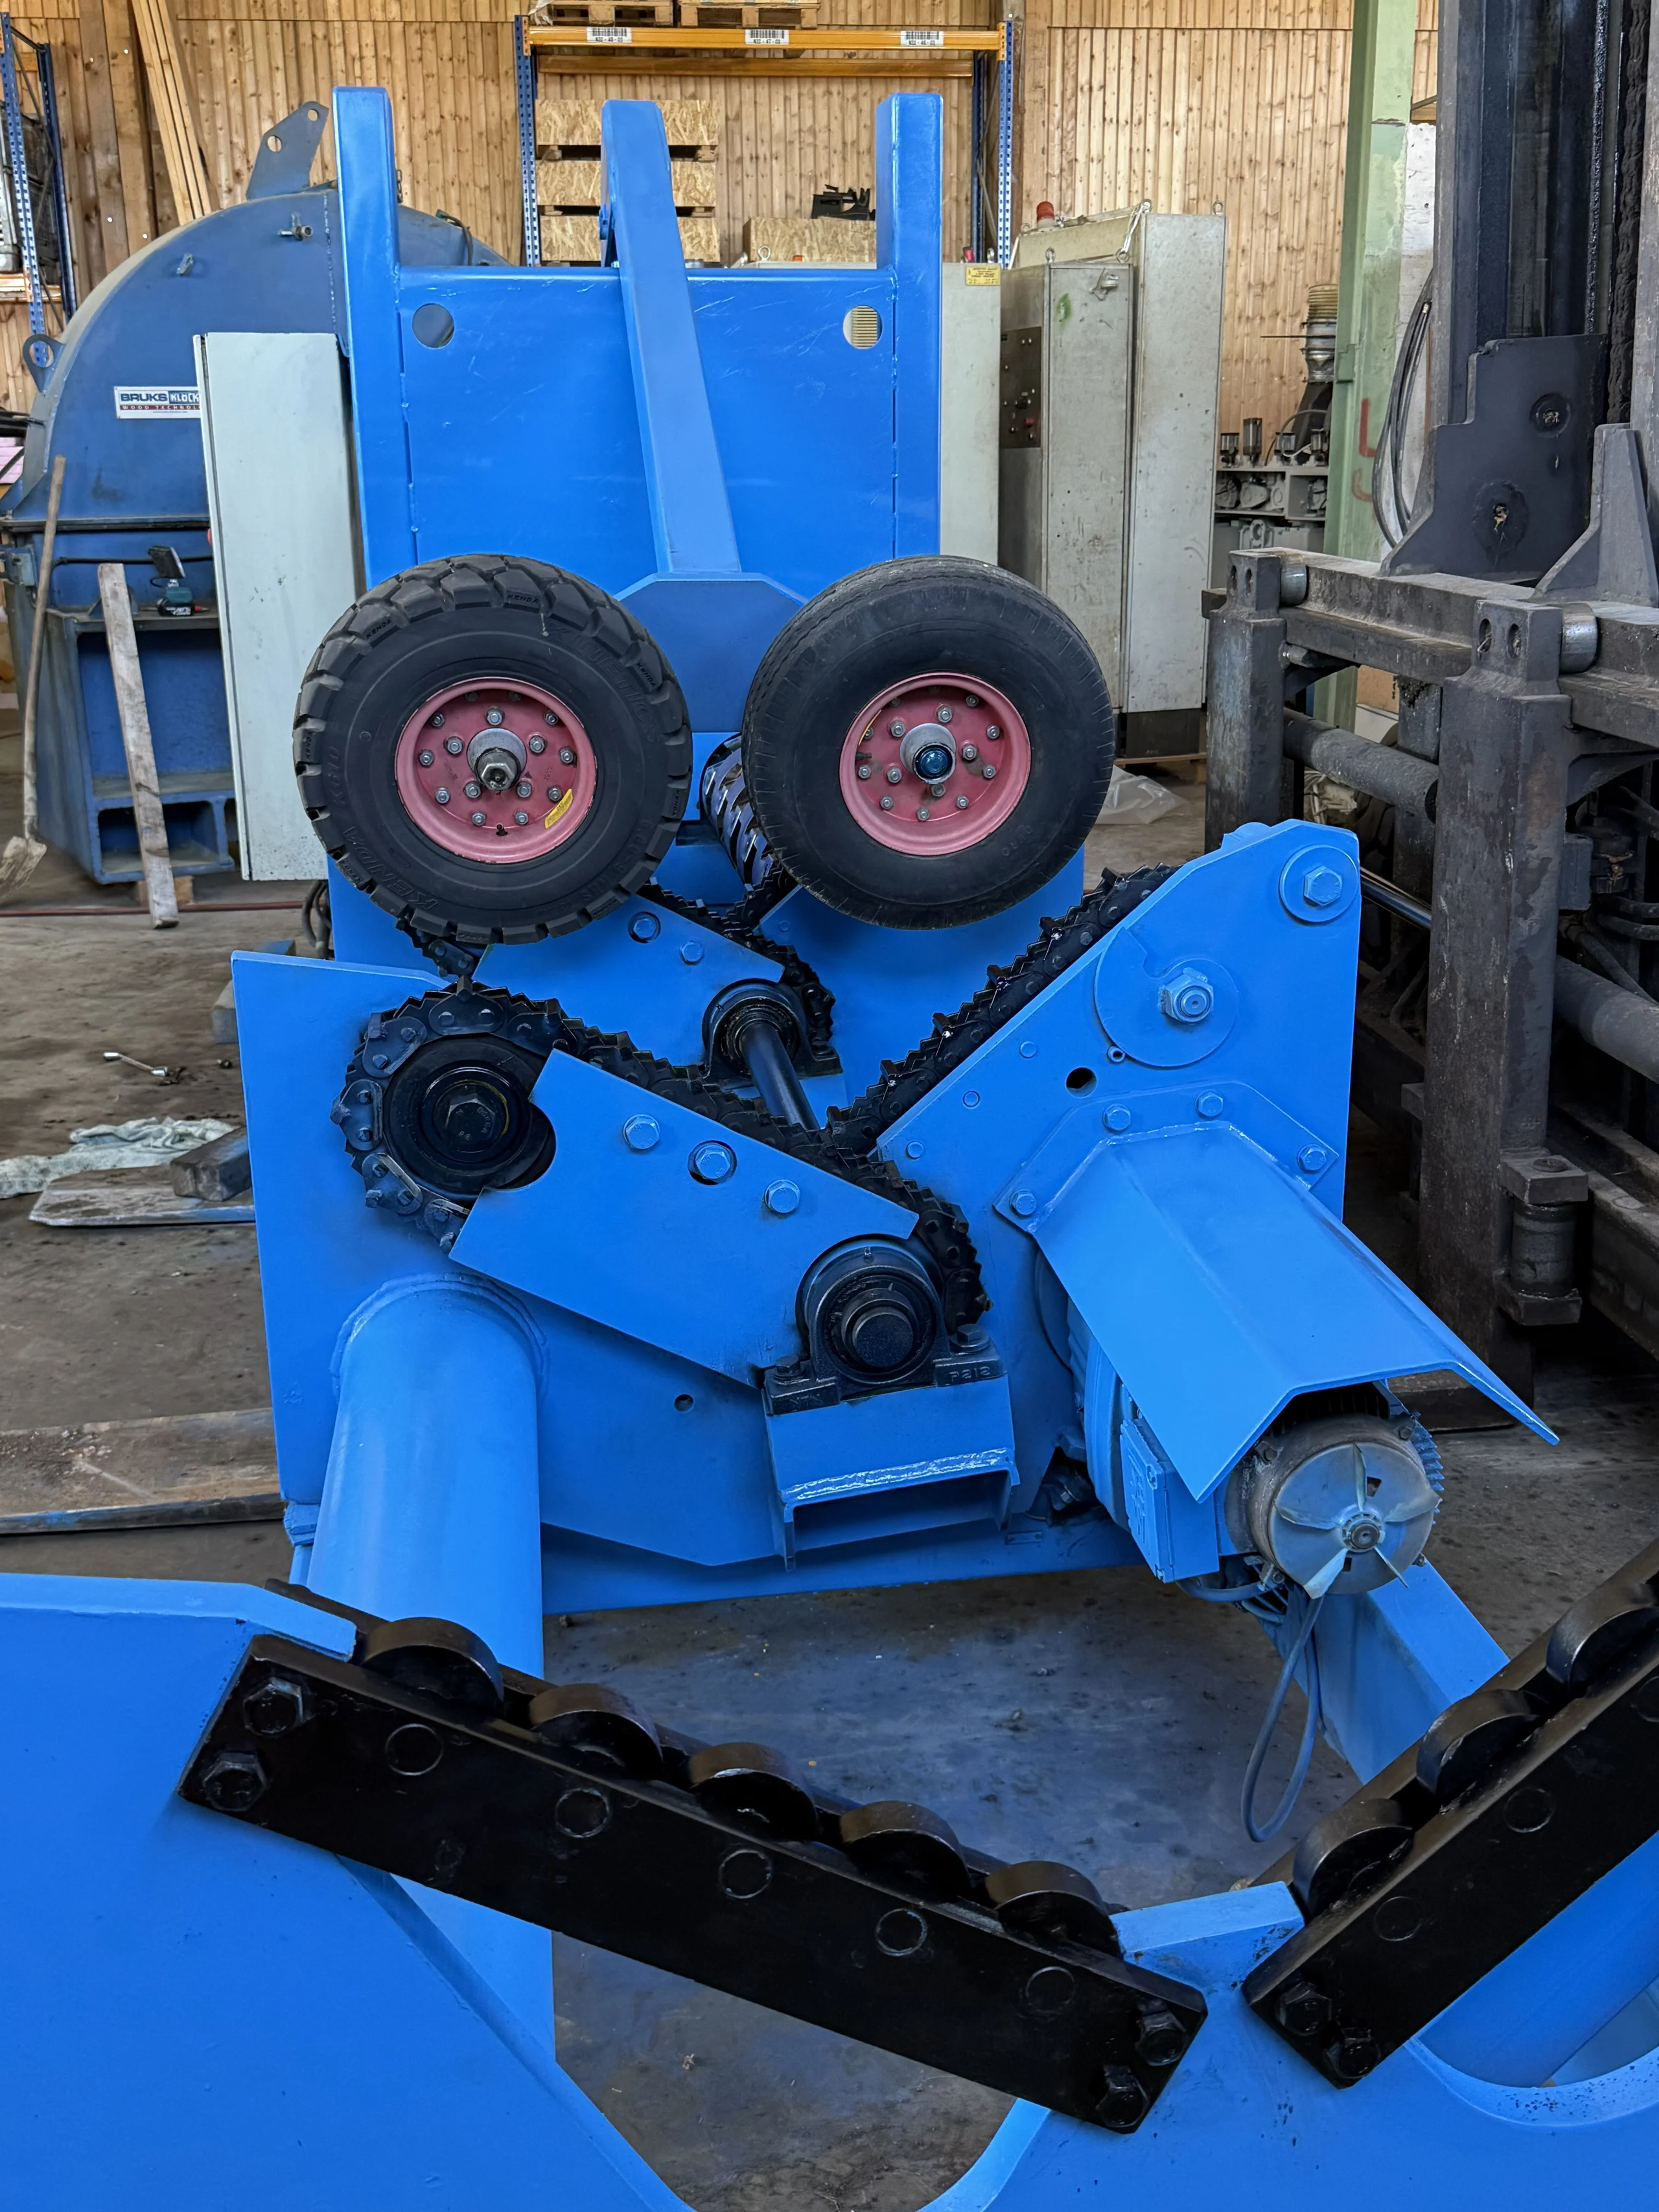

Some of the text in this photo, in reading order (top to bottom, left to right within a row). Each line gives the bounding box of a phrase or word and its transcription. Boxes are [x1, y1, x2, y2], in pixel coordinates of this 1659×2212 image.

[121, 393, 168, 402] BRUKS
[506, 593, 539, 604] KENDA
[365, 618, 392, 639] KENDA
[636, 662, 656, 688] KENDA
[343, 826, 438, 909] KENDA
[949, 1366, 991, 1380] P212
